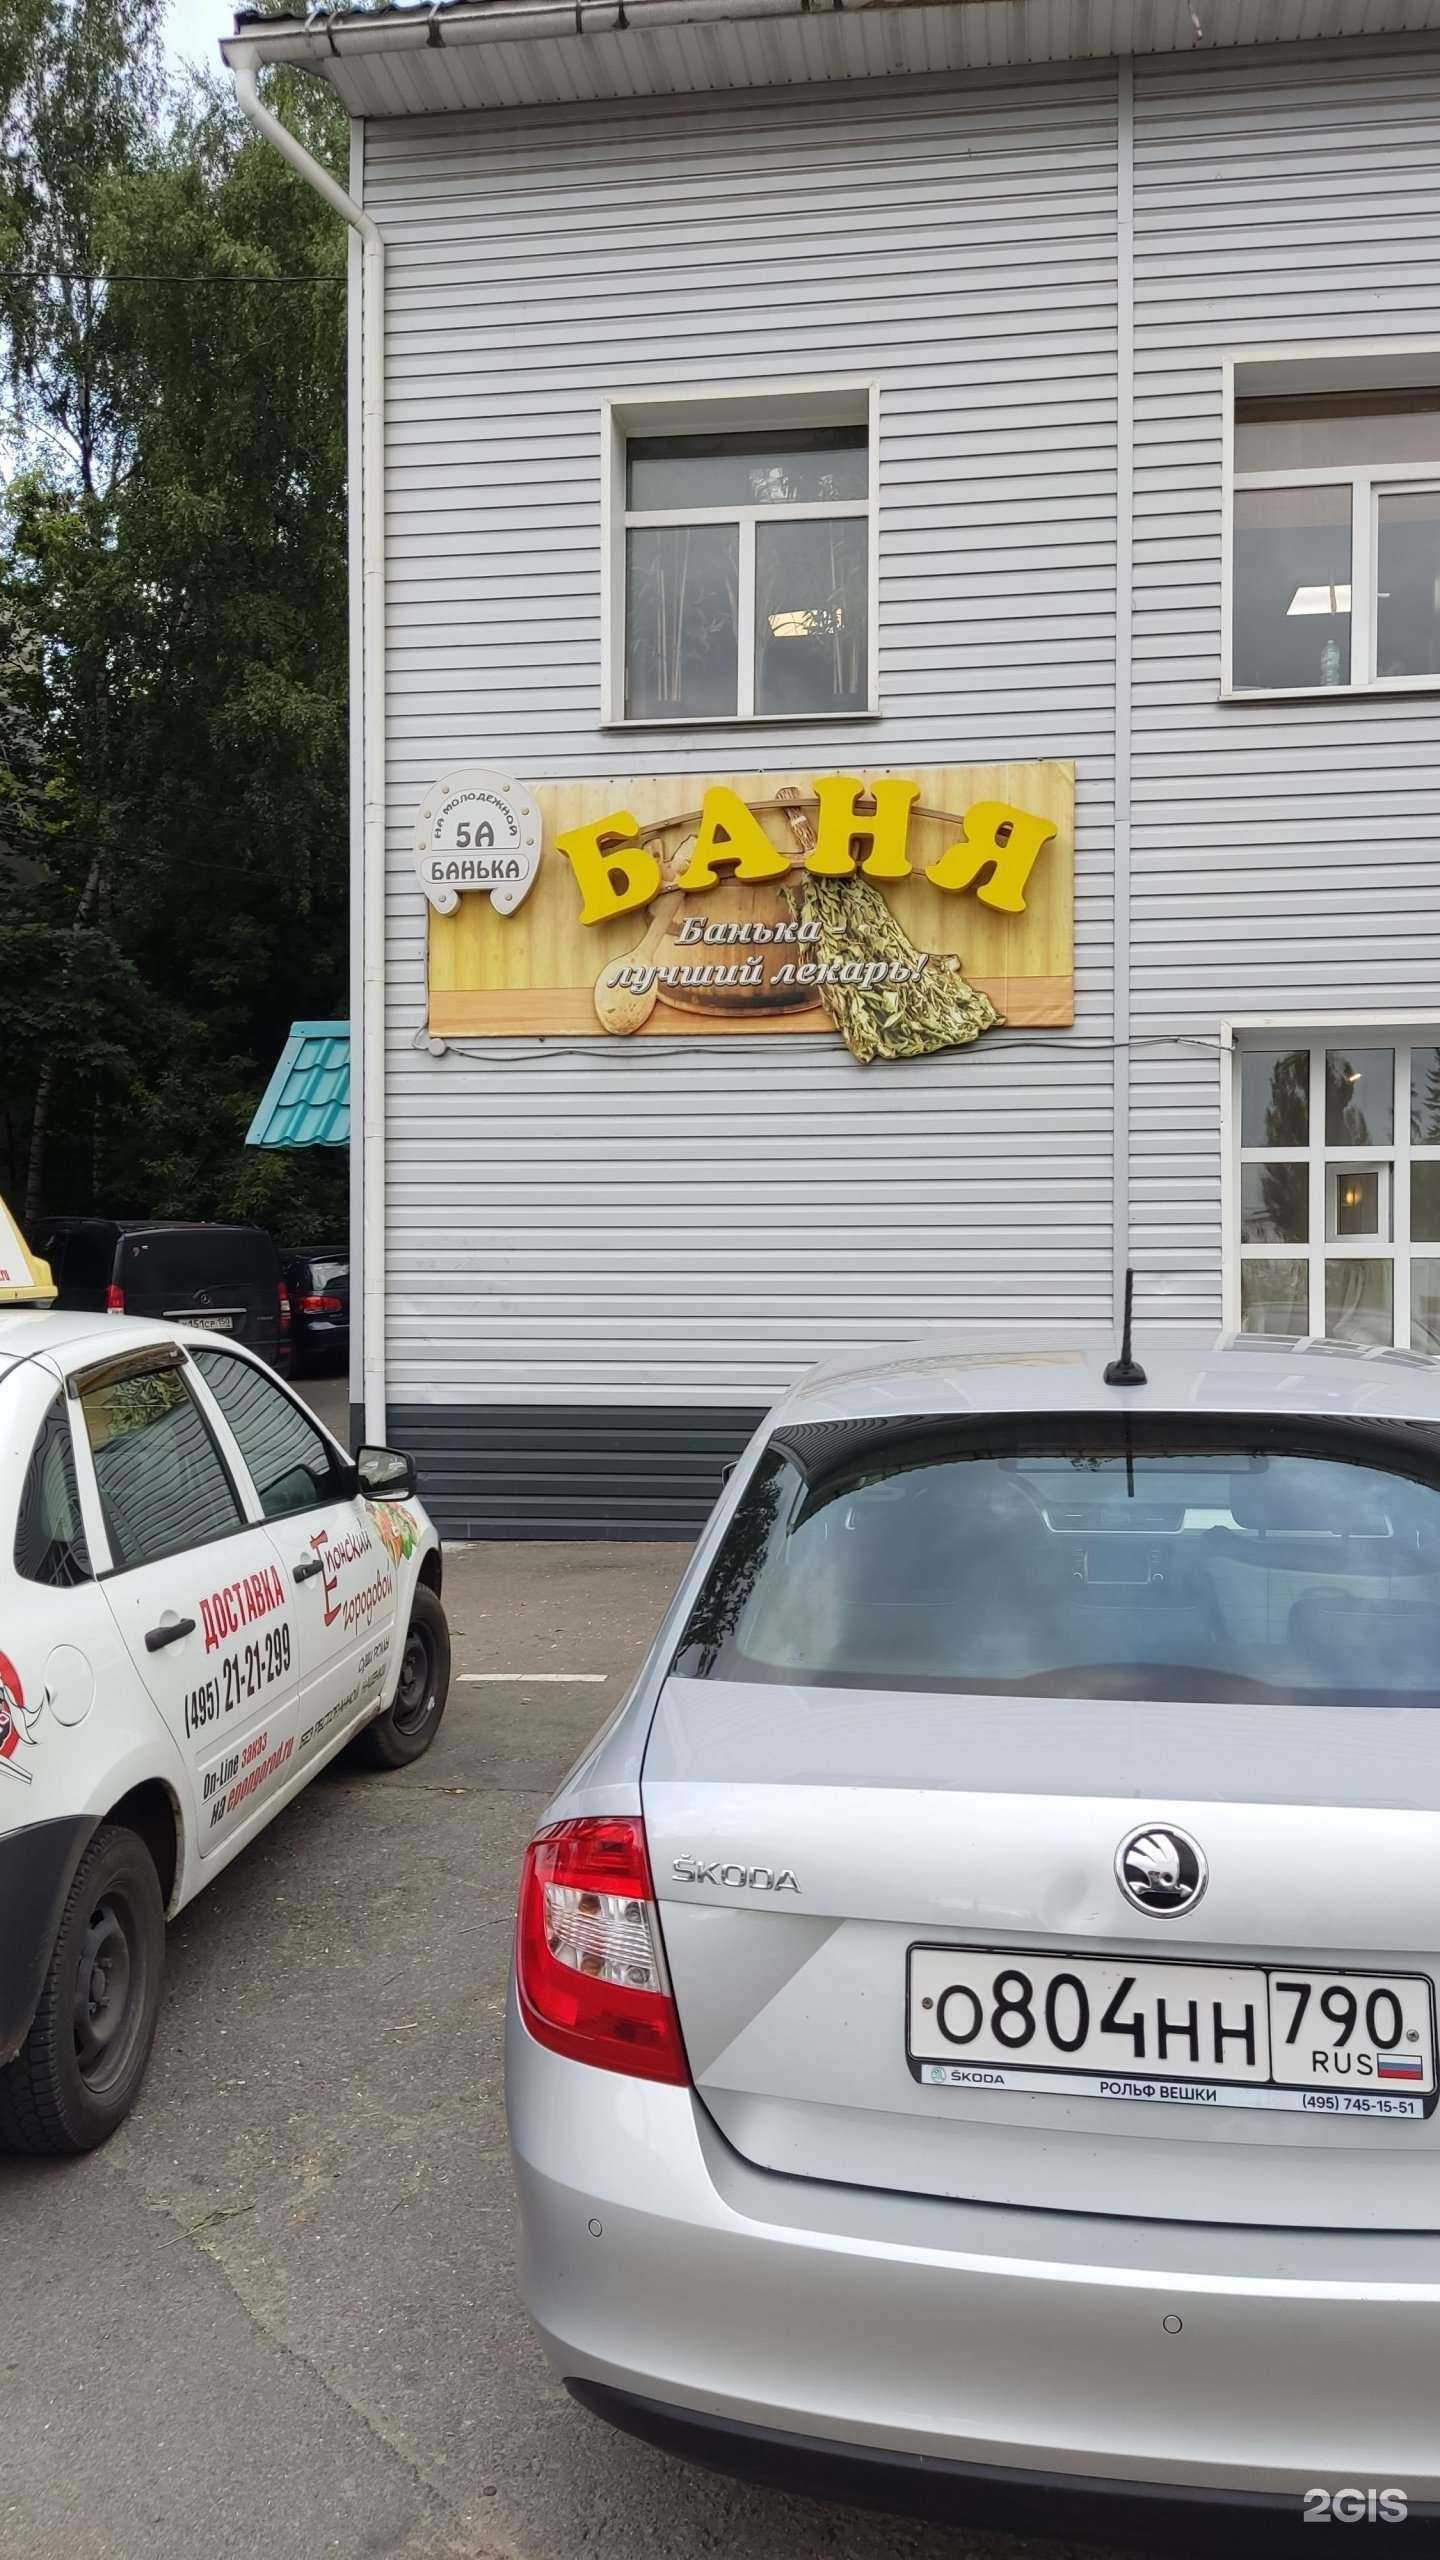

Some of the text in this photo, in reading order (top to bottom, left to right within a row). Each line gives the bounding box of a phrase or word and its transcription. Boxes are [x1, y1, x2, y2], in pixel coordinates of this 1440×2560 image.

[456, 821, 494, 848] 5А
[555, 776, 1059, 928] БАНЯ
[431, 859, 520, 880] БАНЬКА
[674, 916, 824, 946] Банька
[607, 954, 929, 995] лучший лекарь!
[199, 1565, 285, 1655] ДОСТАВКА
[185, 1623, 291, 1738] (495) 21-21-299
[241, 1731, 268, 1768] заказ
[210, 1795, 226, 1828] на
[671, 1854, 802, 1894] ŠKODA
[1276, 1982, 1403, 2050] 790
[1312, 2051, 1374, 2076] RUS
[1100, 2081, 1217, 2102] РОЛЬФ ВЕШКИ
[1302, 2094, 1414, 2114] (495) 745-15-51
